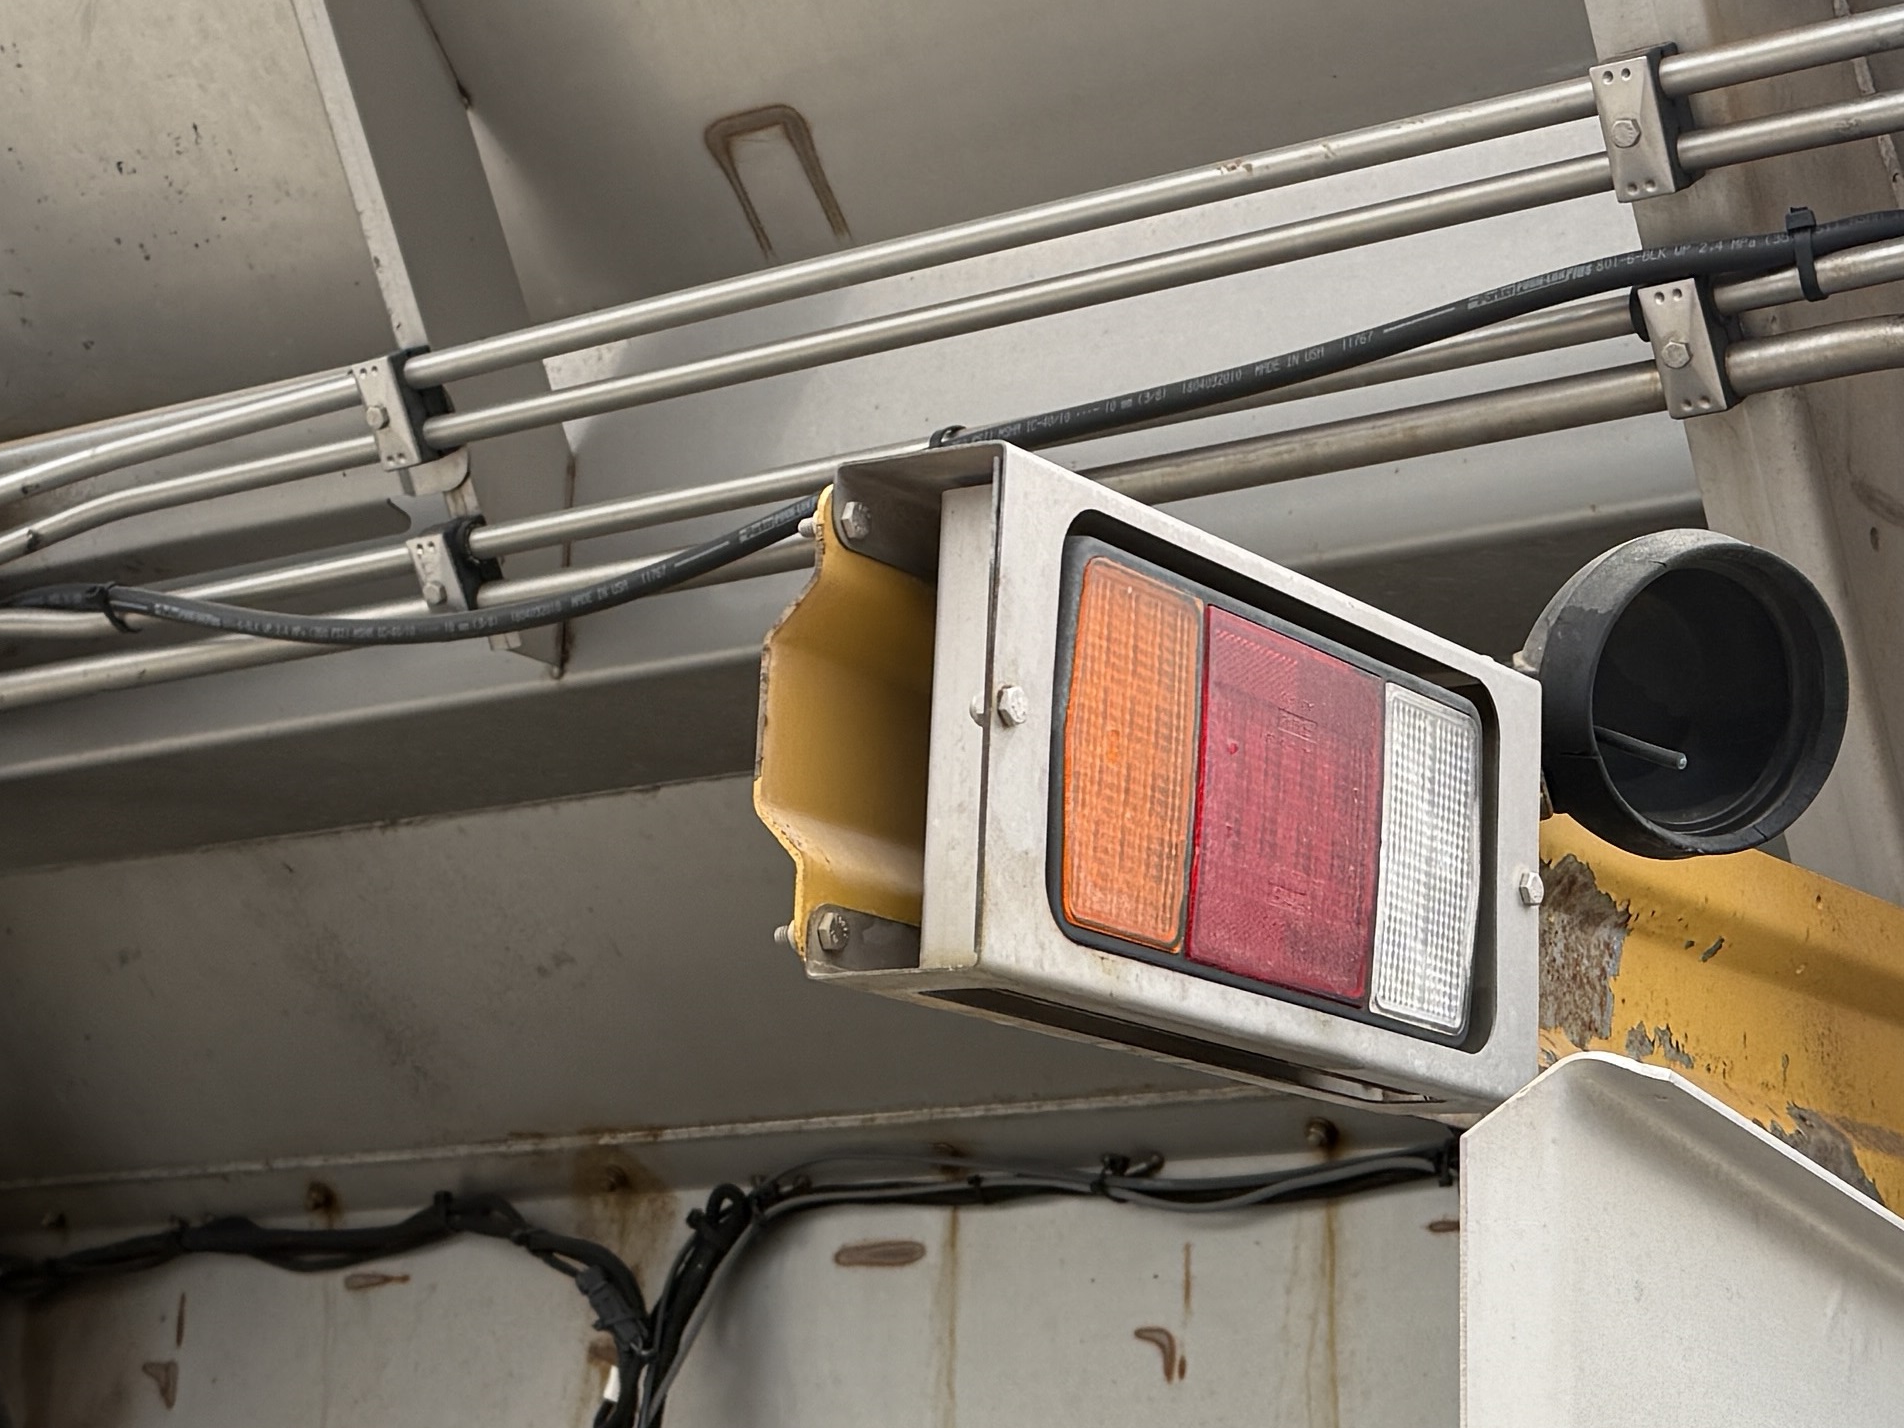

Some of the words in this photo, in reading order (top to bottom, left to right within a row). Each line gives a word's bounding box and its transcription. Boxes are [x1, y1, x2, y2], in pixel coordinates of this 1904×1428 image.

[1730, 235, 1757, 250] MPa
[1254, 359, 1280, 378] MADE
[1287, 352, 1301, 369] IN
[1304, 346, 1325, 363] USA
